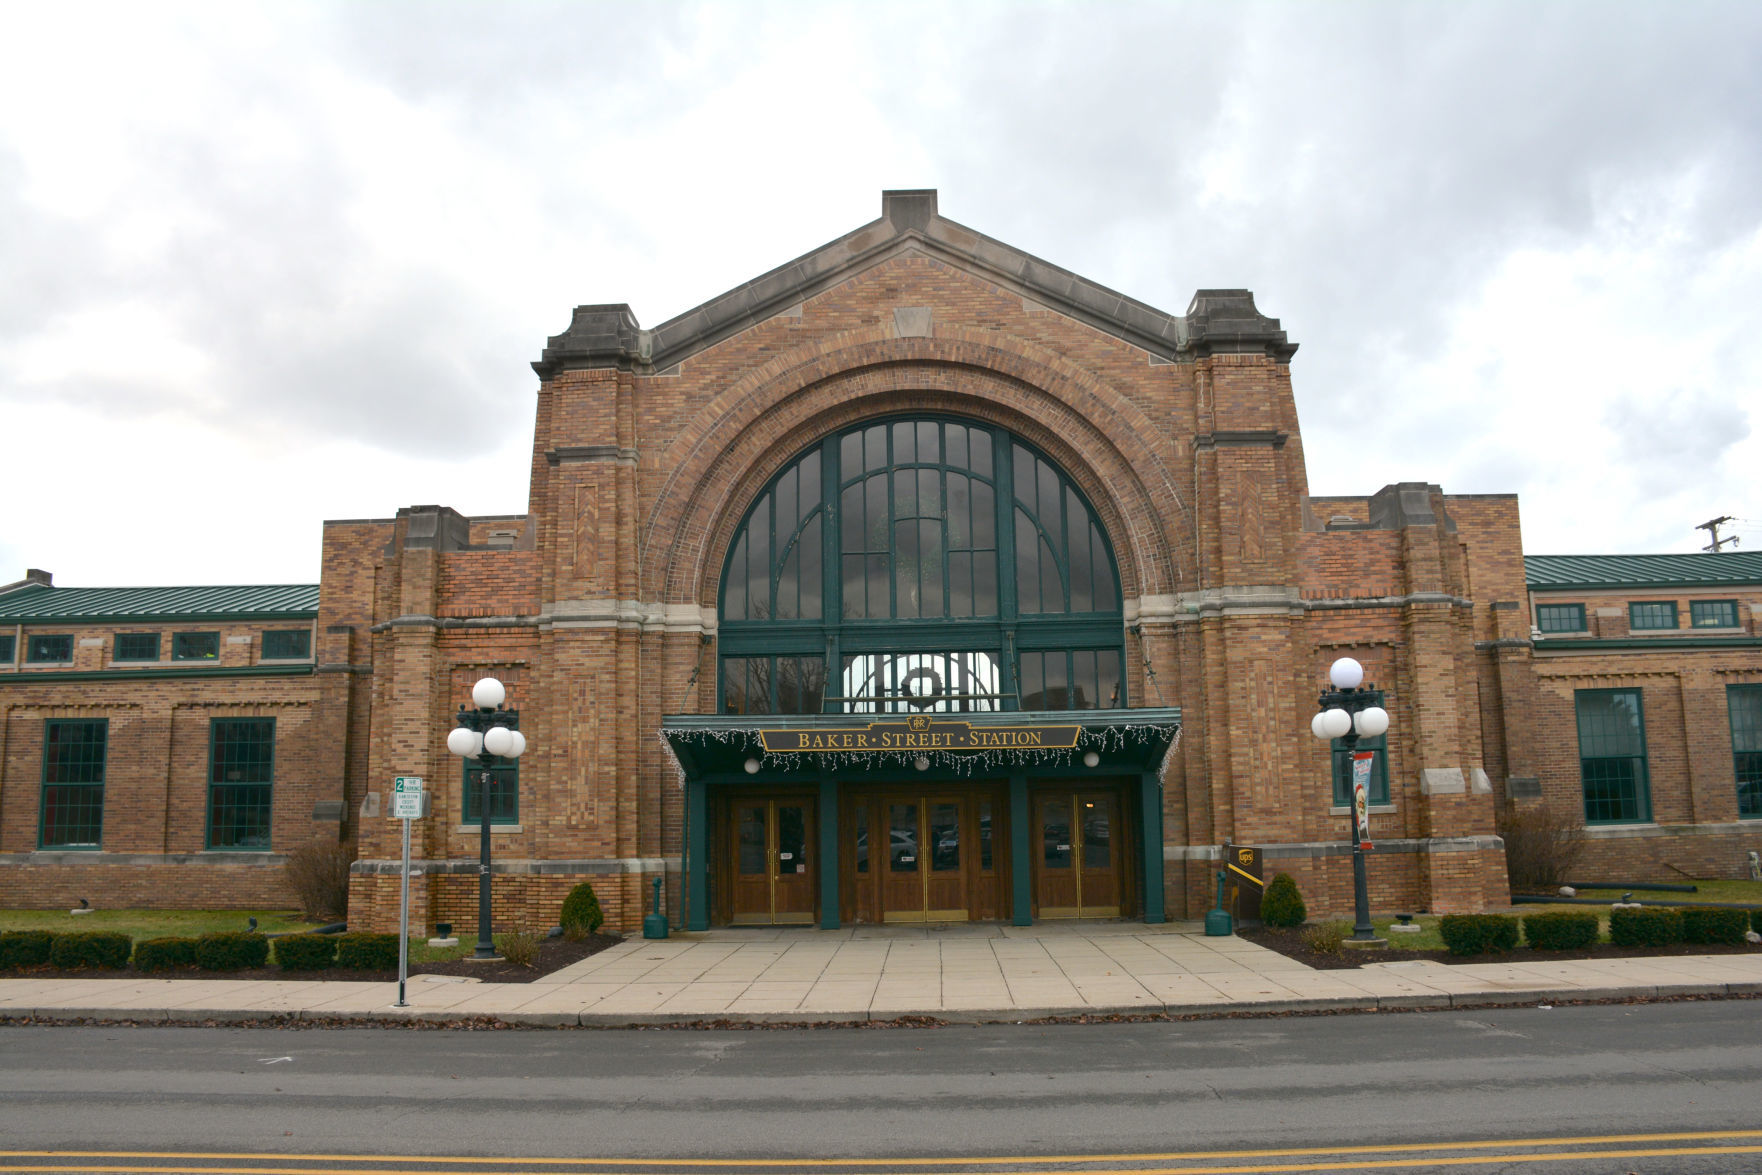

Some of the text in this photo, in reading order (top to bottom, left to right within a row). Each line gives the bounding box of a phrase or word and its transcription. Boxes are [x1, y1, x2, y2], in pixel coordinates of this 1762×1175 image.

[798, 730, 1042, 748] BAKER STREET STATION
[396, 780, 403, 791] 2
